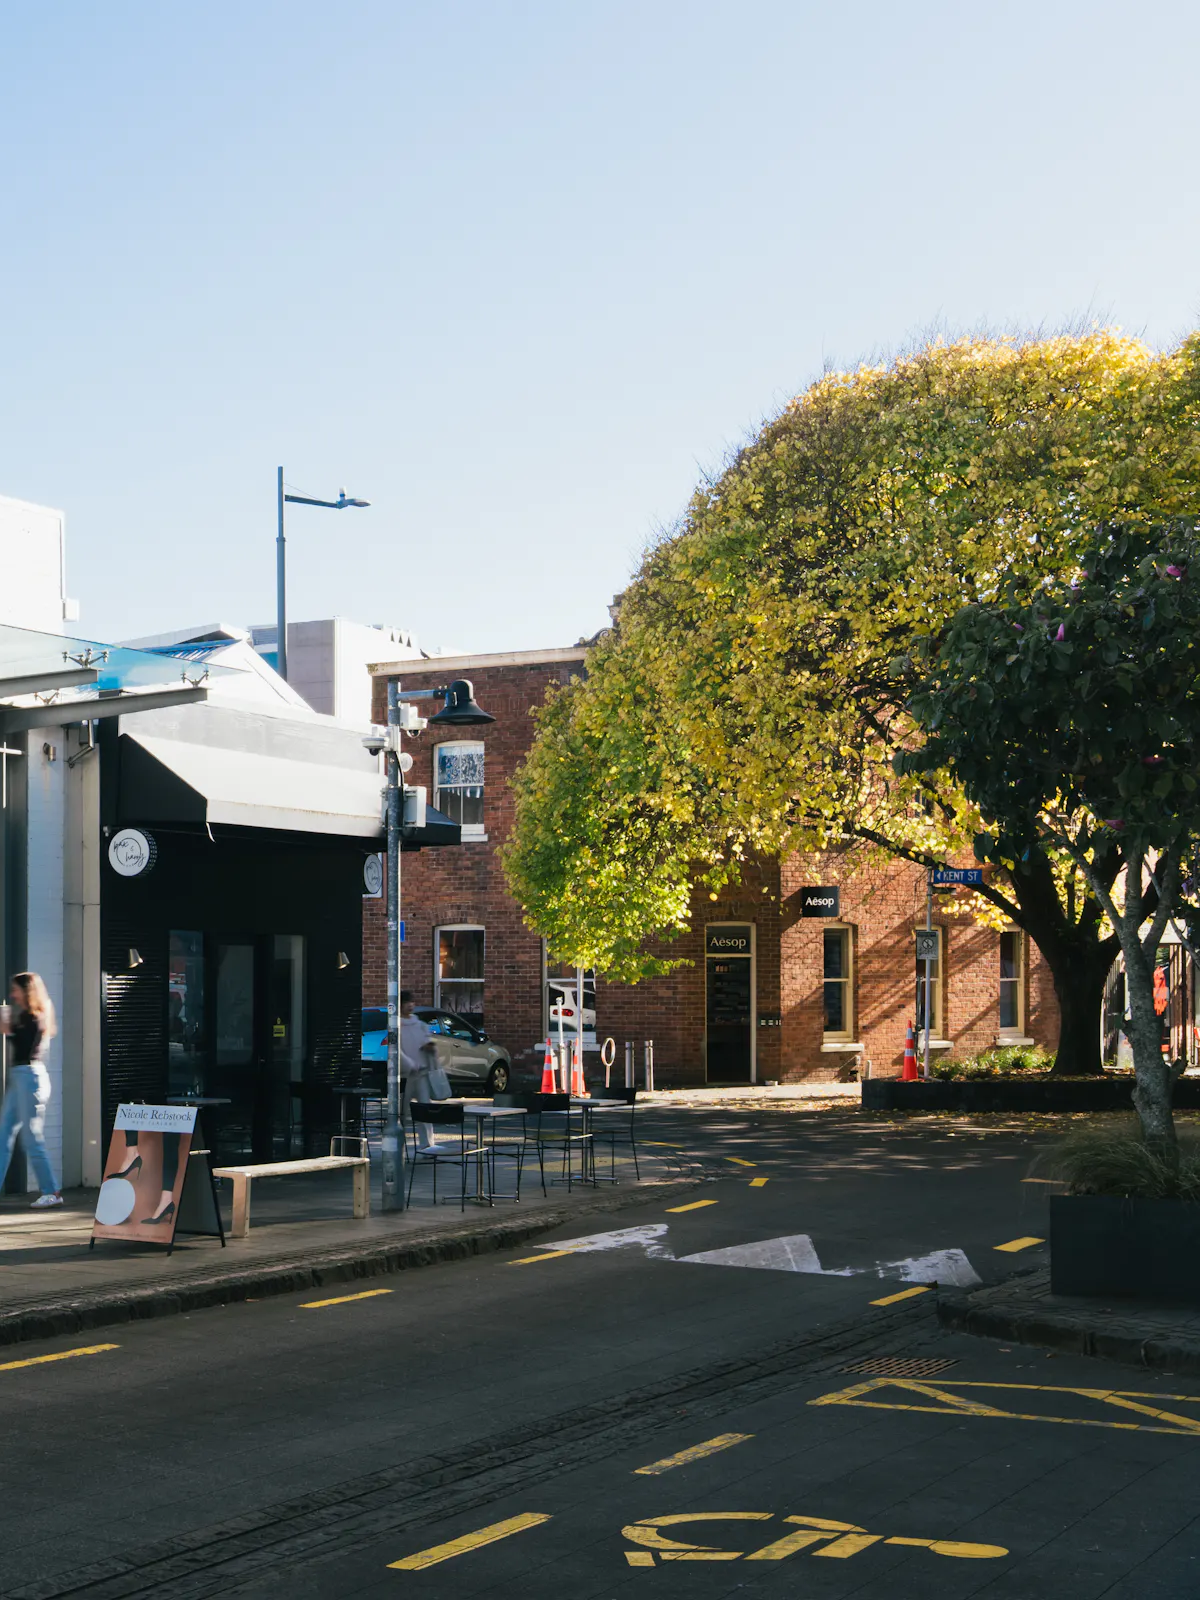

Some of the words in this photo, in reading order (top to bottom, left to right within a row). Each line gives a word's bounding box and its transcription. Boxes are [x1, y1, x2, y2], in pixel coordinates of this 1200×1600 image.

[943, 871, 964, 881] KENT
[967, 871, 979, 881] ST
[120, 1108, 148, 1119] Nicole
[150, 1109, 192, 1121] Rebstock
